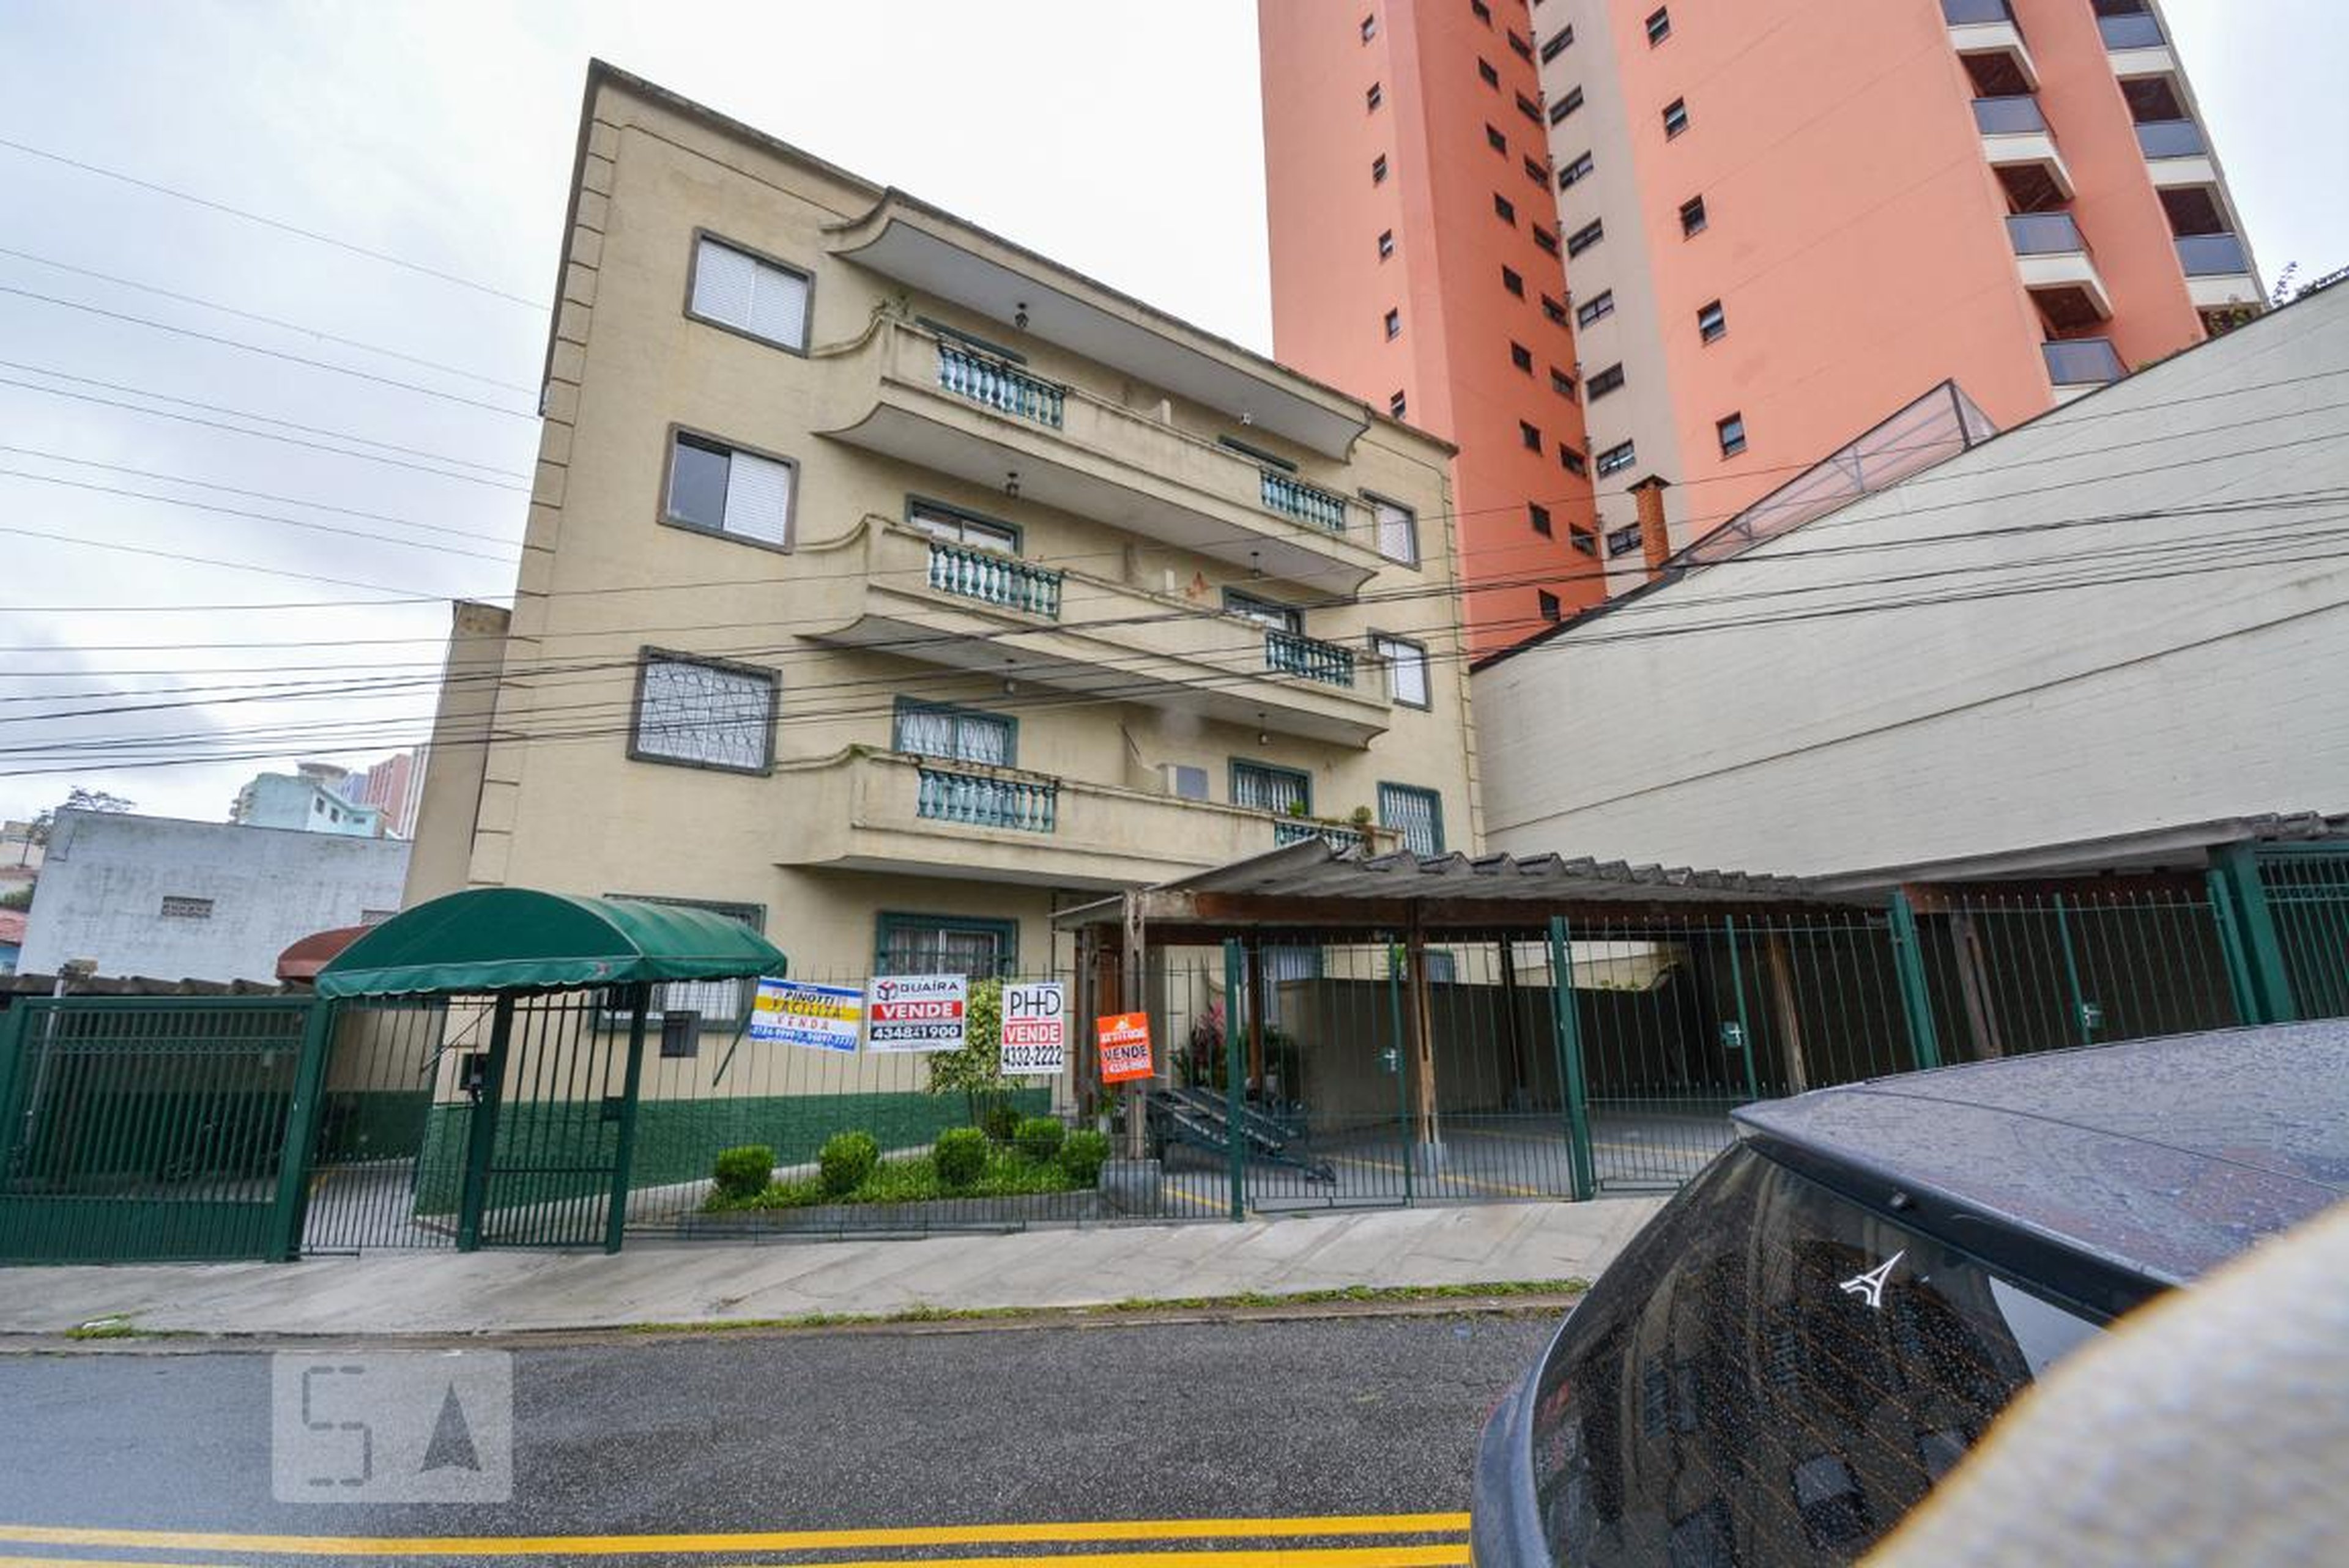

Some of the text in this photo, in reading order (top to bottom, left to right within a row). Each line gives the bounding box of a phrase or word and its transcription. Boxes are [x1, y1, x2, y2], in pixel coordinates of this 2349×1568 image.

[881, 1002, 953, 1019] VENDE
[1011, 989, 1061, 1016] PHD
[777, 1015, 829, 1030] VENDA
[1005, 1024, 1059, 1043] VENDE
[1003, 1045, 1063, 1067] 4332-2222
[1102, 1045, 1148, 1061] VENDE
